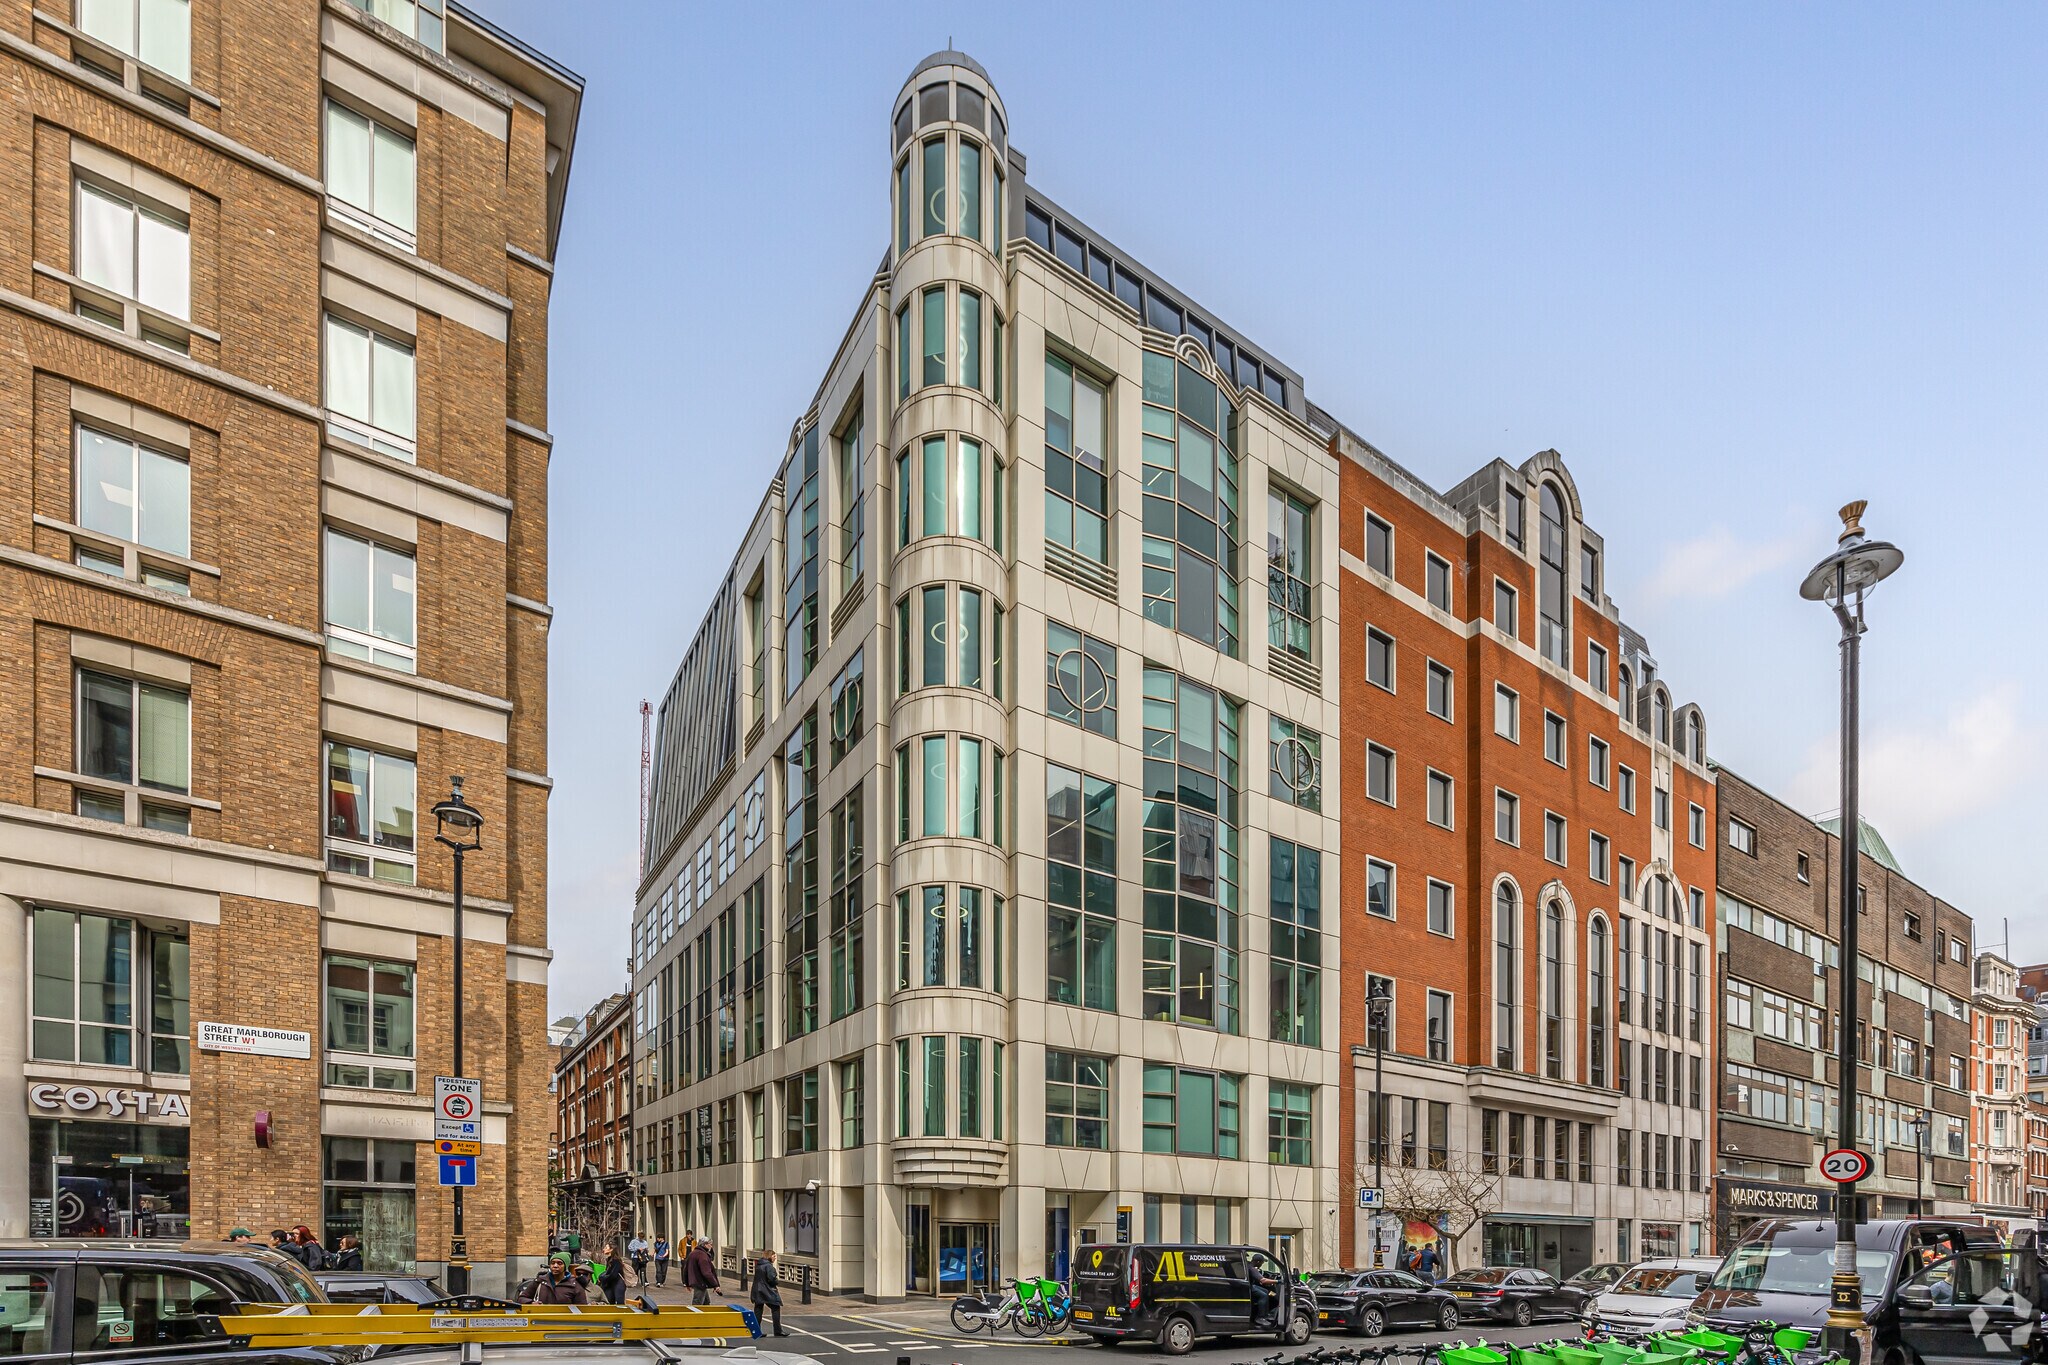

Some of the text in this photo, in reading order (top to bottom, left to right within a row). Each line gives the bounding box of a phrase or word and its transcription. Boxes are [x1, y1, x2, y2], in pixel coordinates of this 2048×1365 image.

[204, 1024, 305, 1042] GREAT MARLBOROUGH
[204, 1033, 256, 1045] STREET W1
[438, 1077, 478, 1086] PEDESTRIAN
[443, 1084, 472, 1093] ZONE
[30, 1083, 189, 1117] COSTA
[1827, 1158, 1860, 1173] 20
[1730, 1187, 1819, 1210] MARKS&SPENCER
[1189, 1254, 1215, 1262] ADDISON
